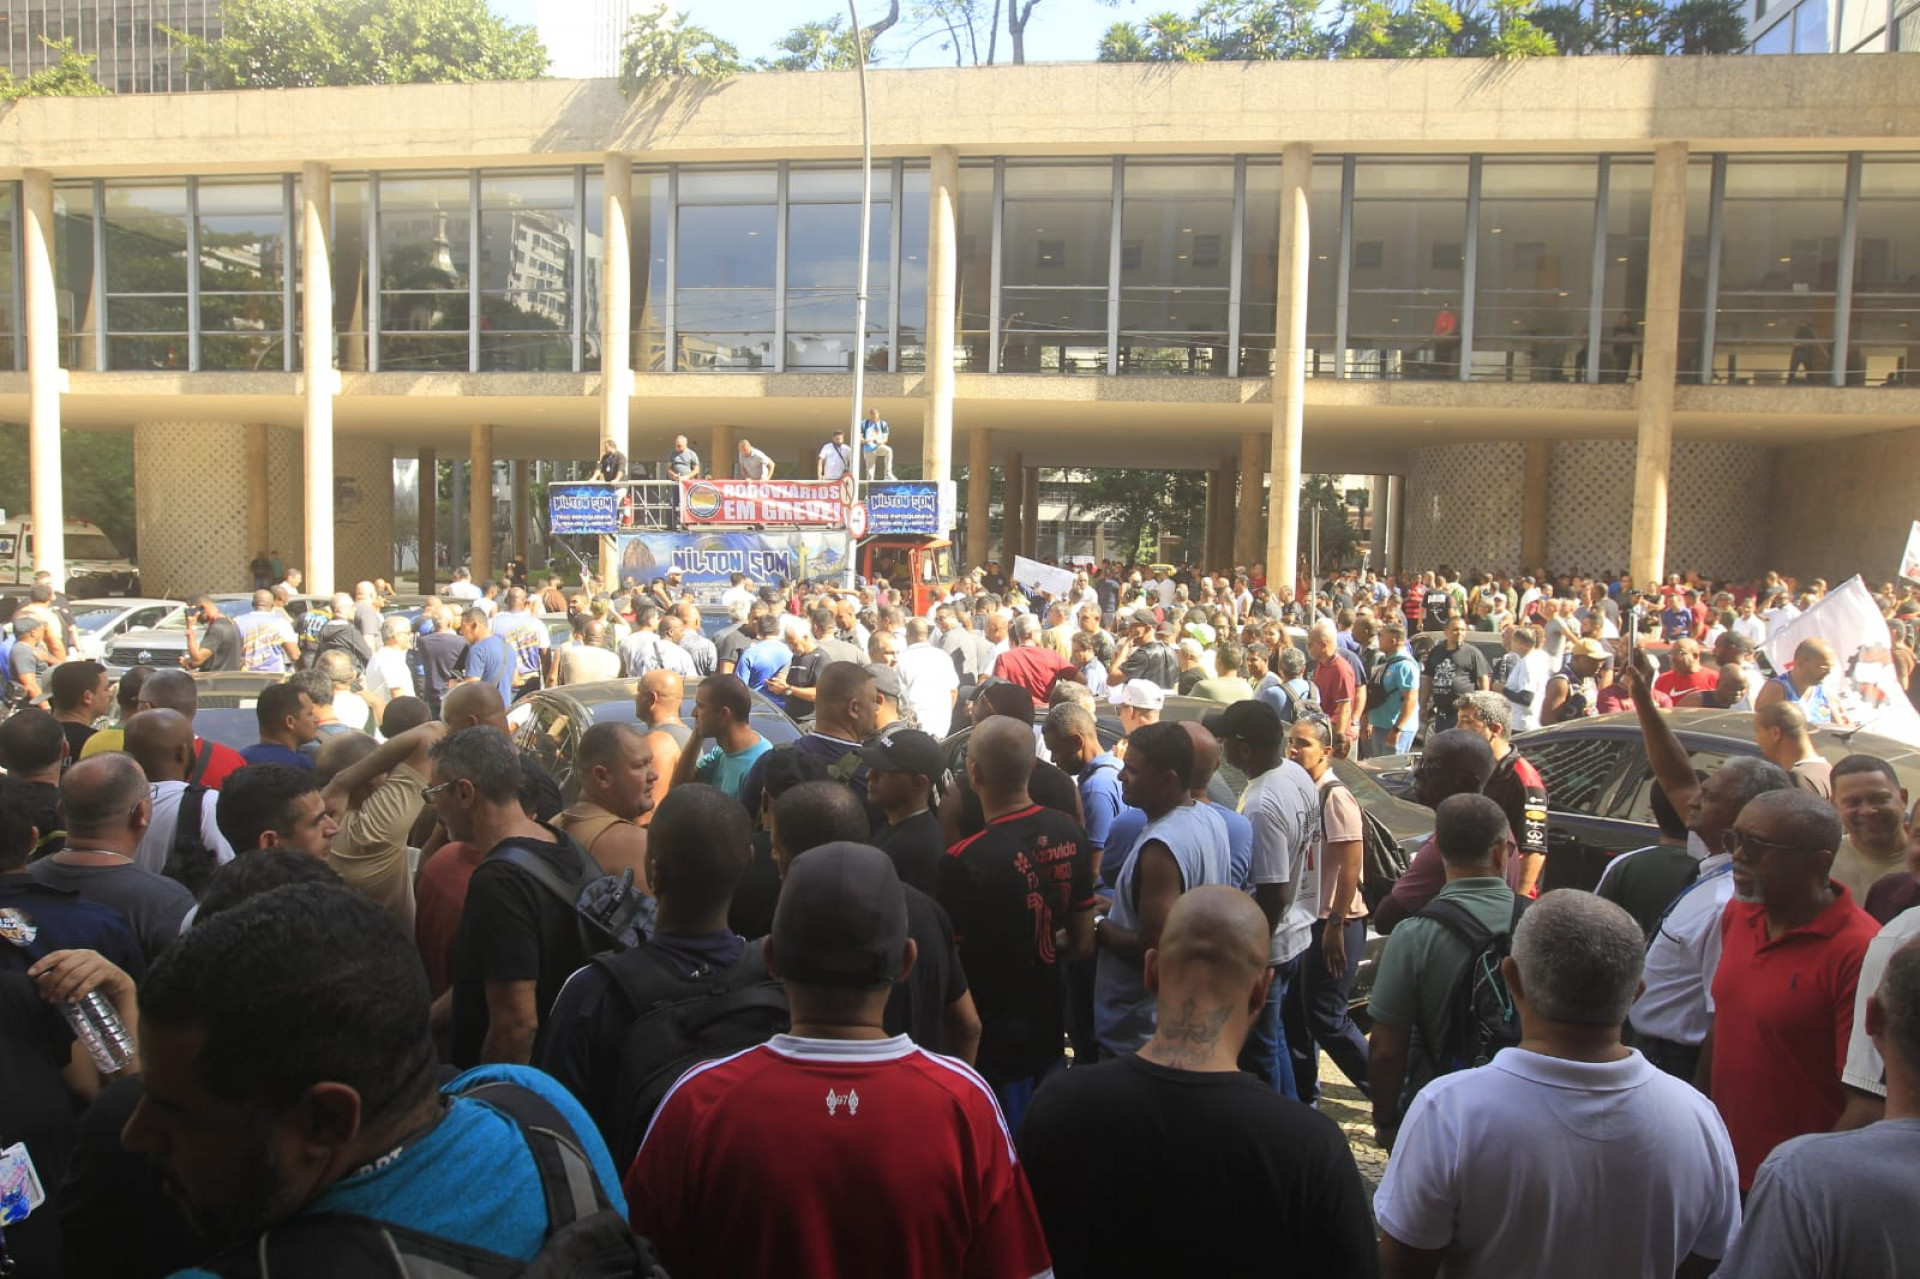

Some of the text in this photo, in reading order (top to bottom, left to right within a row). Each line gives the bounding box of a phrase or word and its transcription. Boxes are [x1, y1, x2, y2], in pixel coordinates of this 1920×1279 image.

[592, 496, 613, 512] SOM
[724, 499, 756, 521] EM
[912, 494, 935, 512] SOM
[672, 547, 792, 580] NILTON SOM
